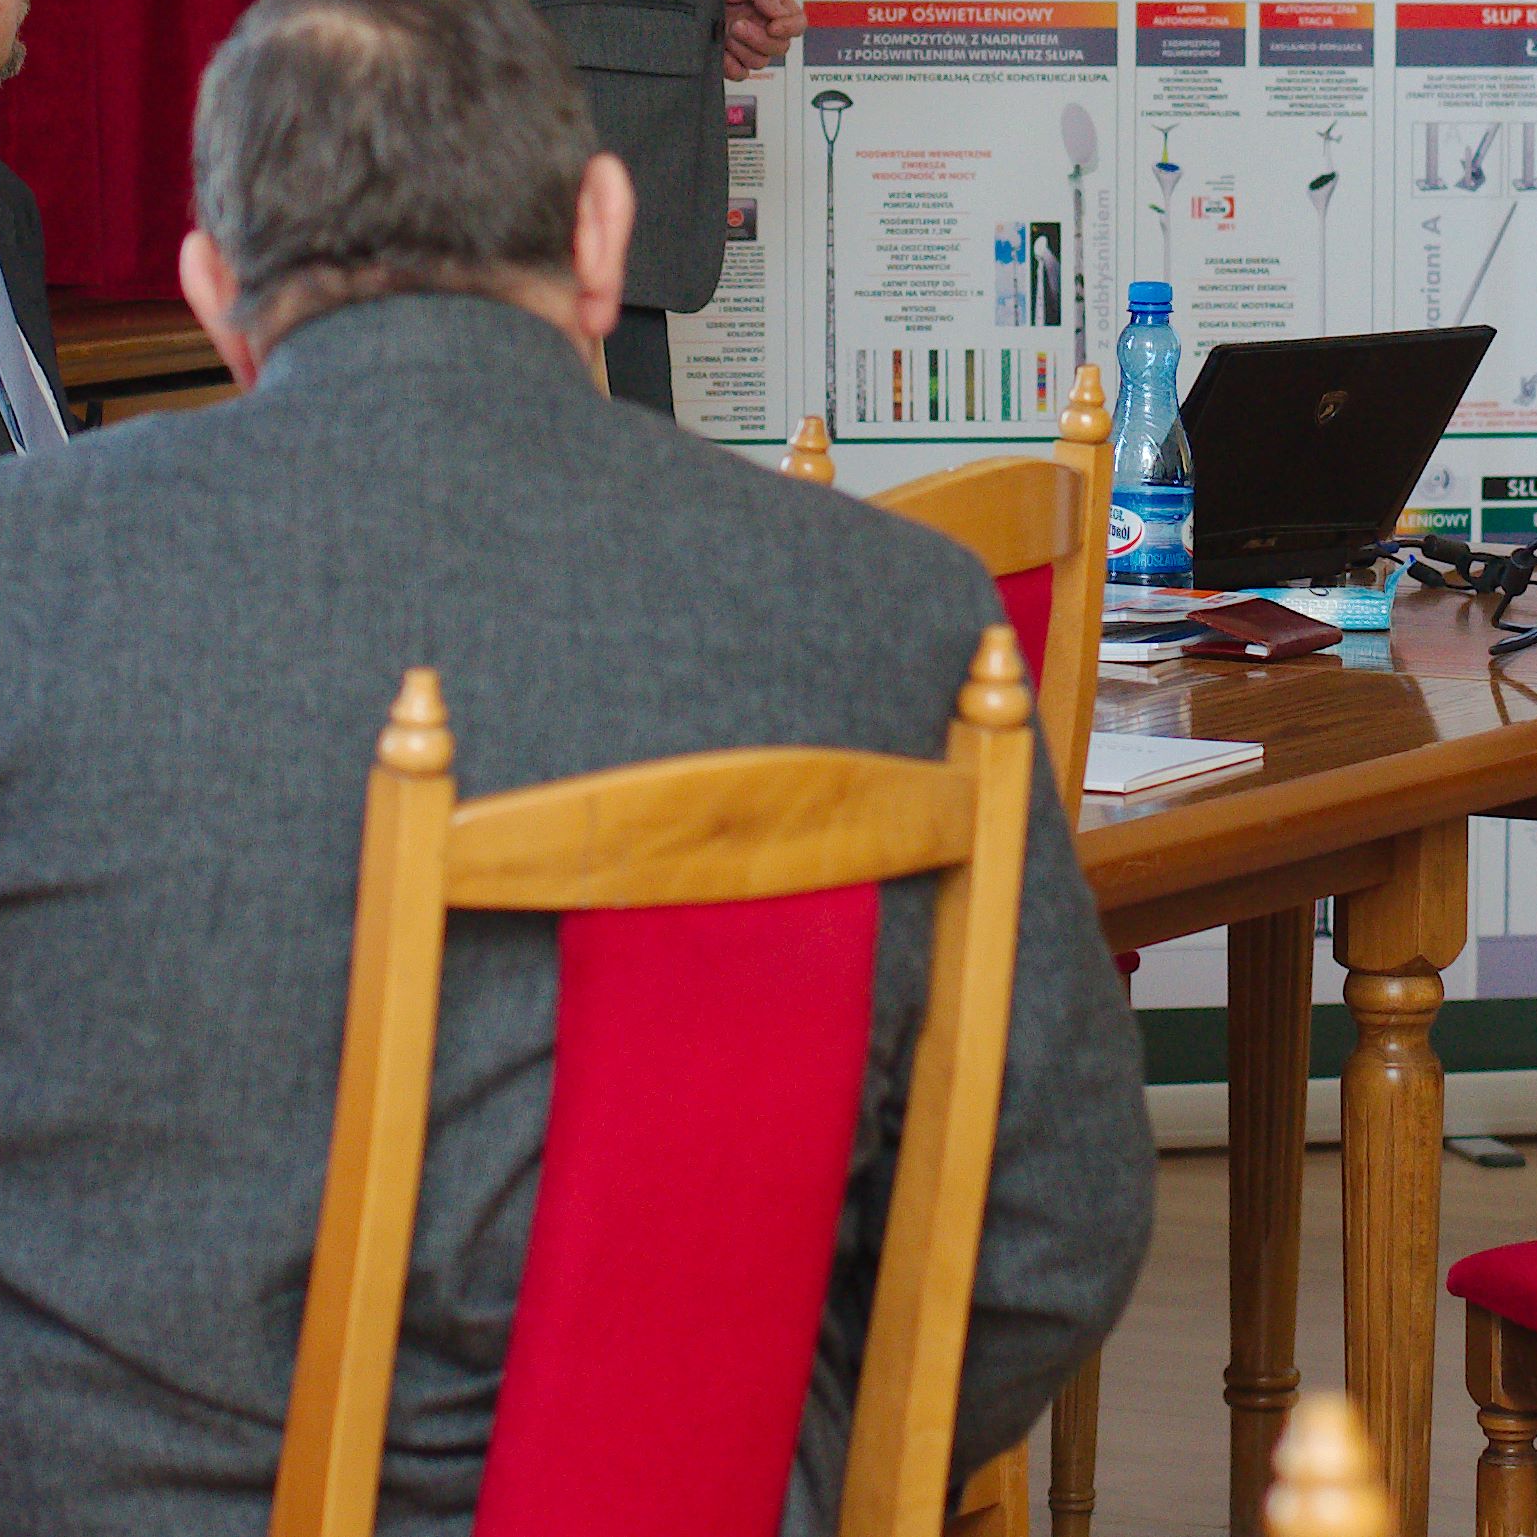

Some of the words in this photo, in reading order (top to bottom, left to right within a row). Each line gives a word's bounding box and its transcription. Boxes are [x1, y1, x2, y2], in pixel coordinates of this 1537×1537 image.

[867, 7, 906, 22] SŁUP
[912, 5, 1055, 23] OŚWIETLENIOWY
[1482, 9, 1523, 25] SŁUP
[981, 34, 1059, 46] NADRUKIEM
[1421, 215, 1442, 236] A
[1093, 190, 1113, 331] odbłyśnikiem
